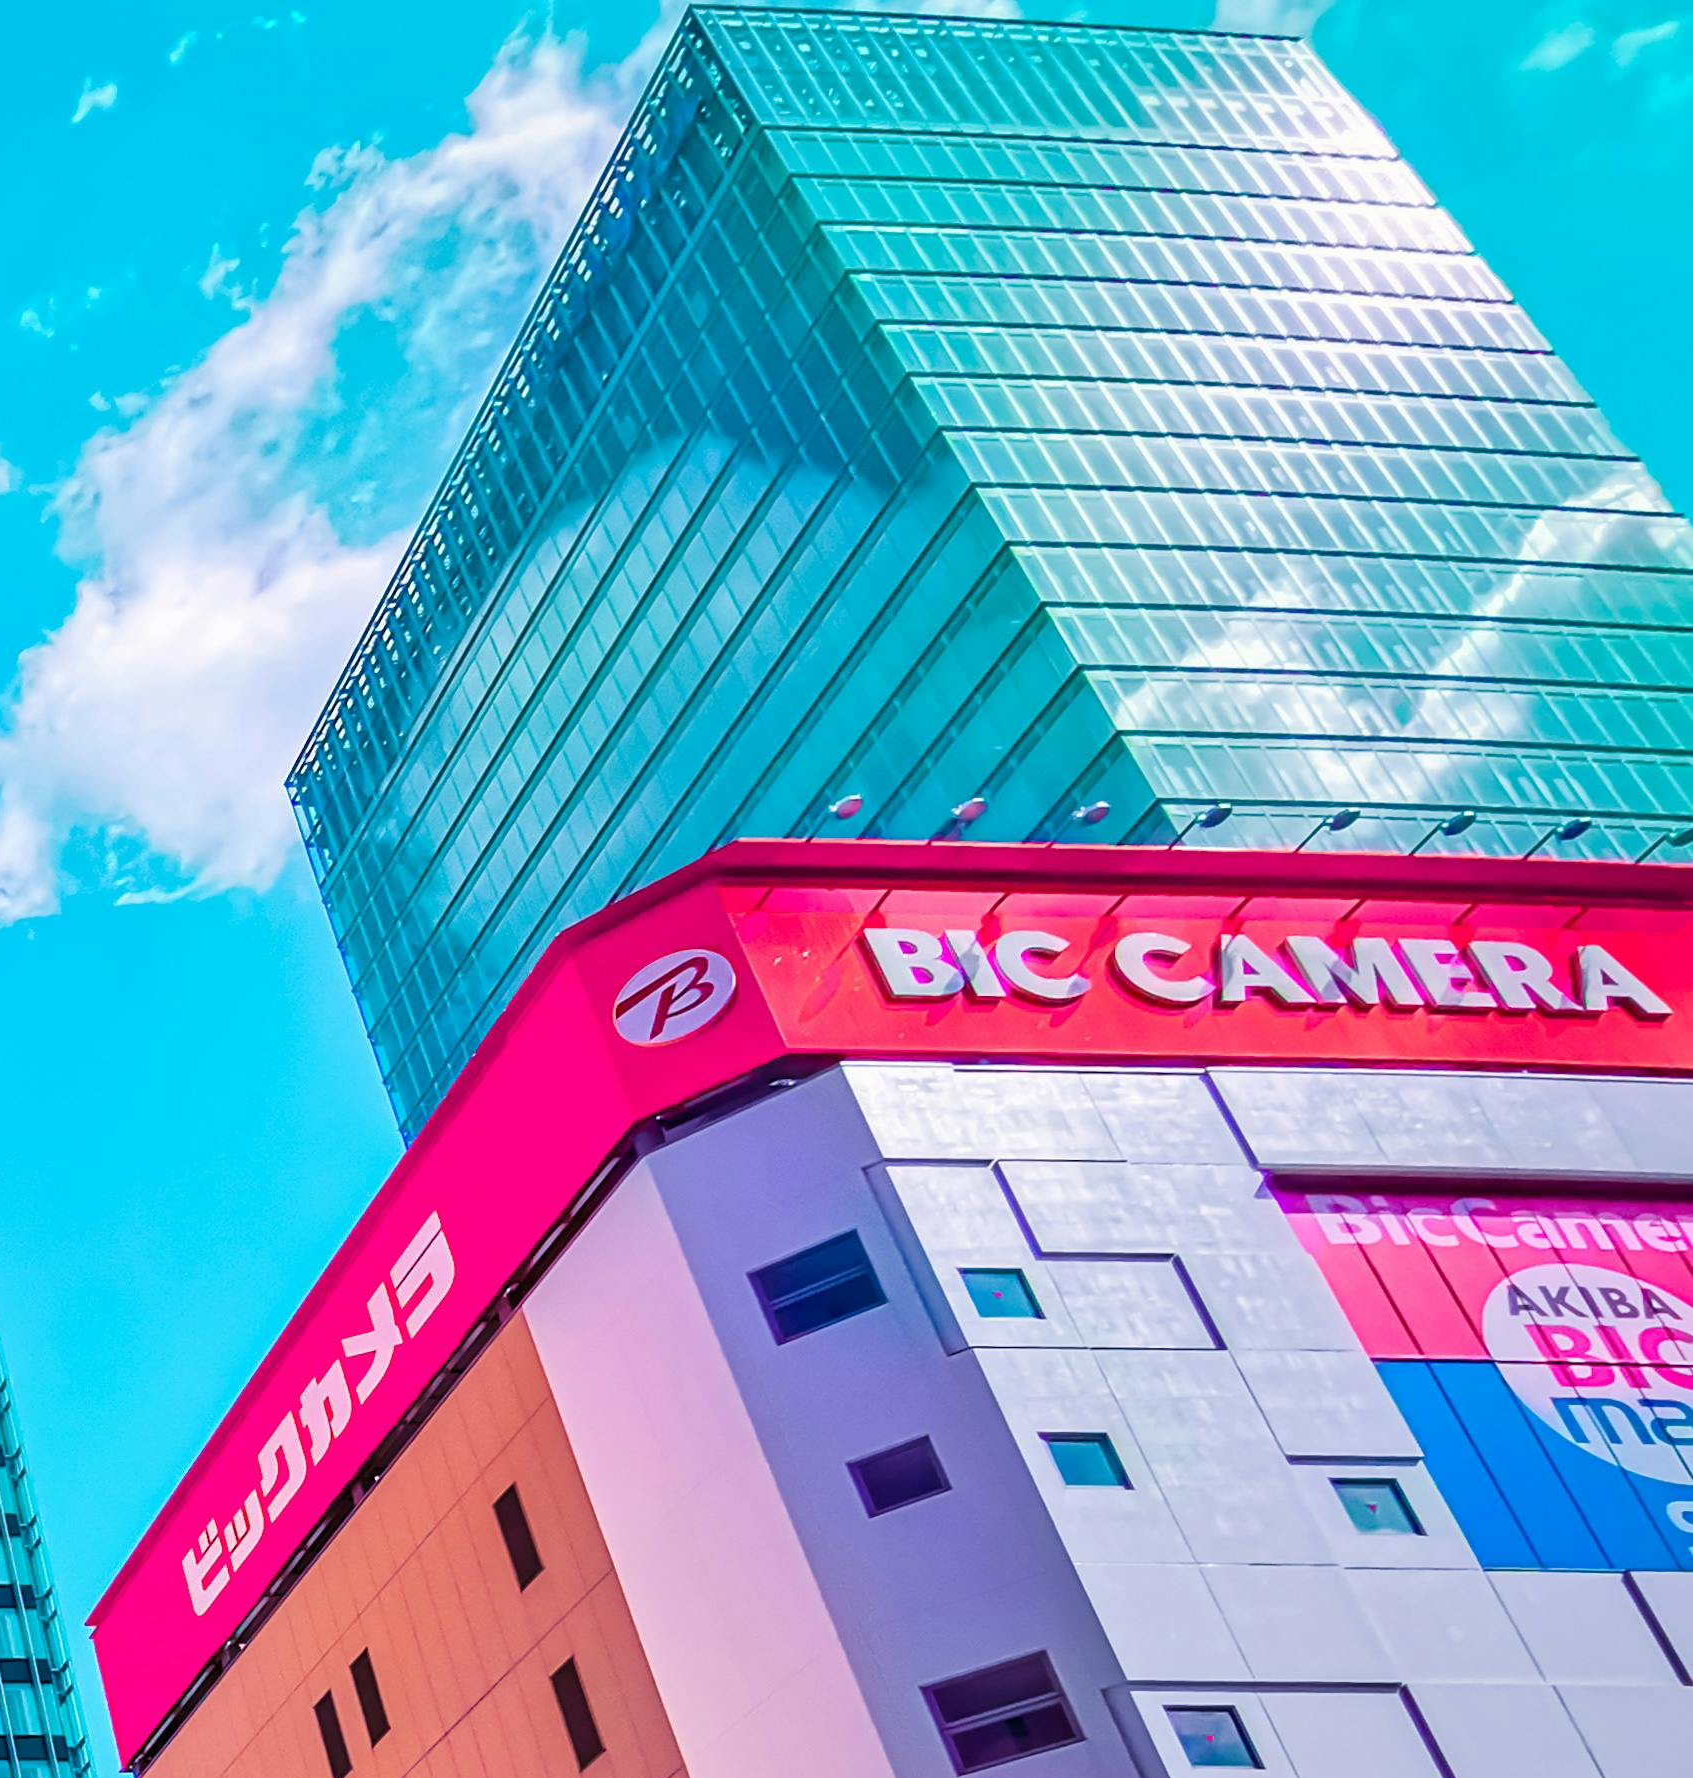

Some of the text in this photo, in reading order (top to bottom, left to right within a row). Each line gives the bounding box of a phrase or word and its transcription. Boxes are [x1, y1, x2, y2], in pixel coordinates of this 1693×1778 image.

[864, 926, 1671, 1020] BIC CAMERA
[1304, 1193, 1693, 1253] BicCame
[1507, 1284, 1683, 1322] AKIBA
[1525, 1324, 1693, 1391] BIC
[180, 1211, 457, 1618] ビックカメラ
